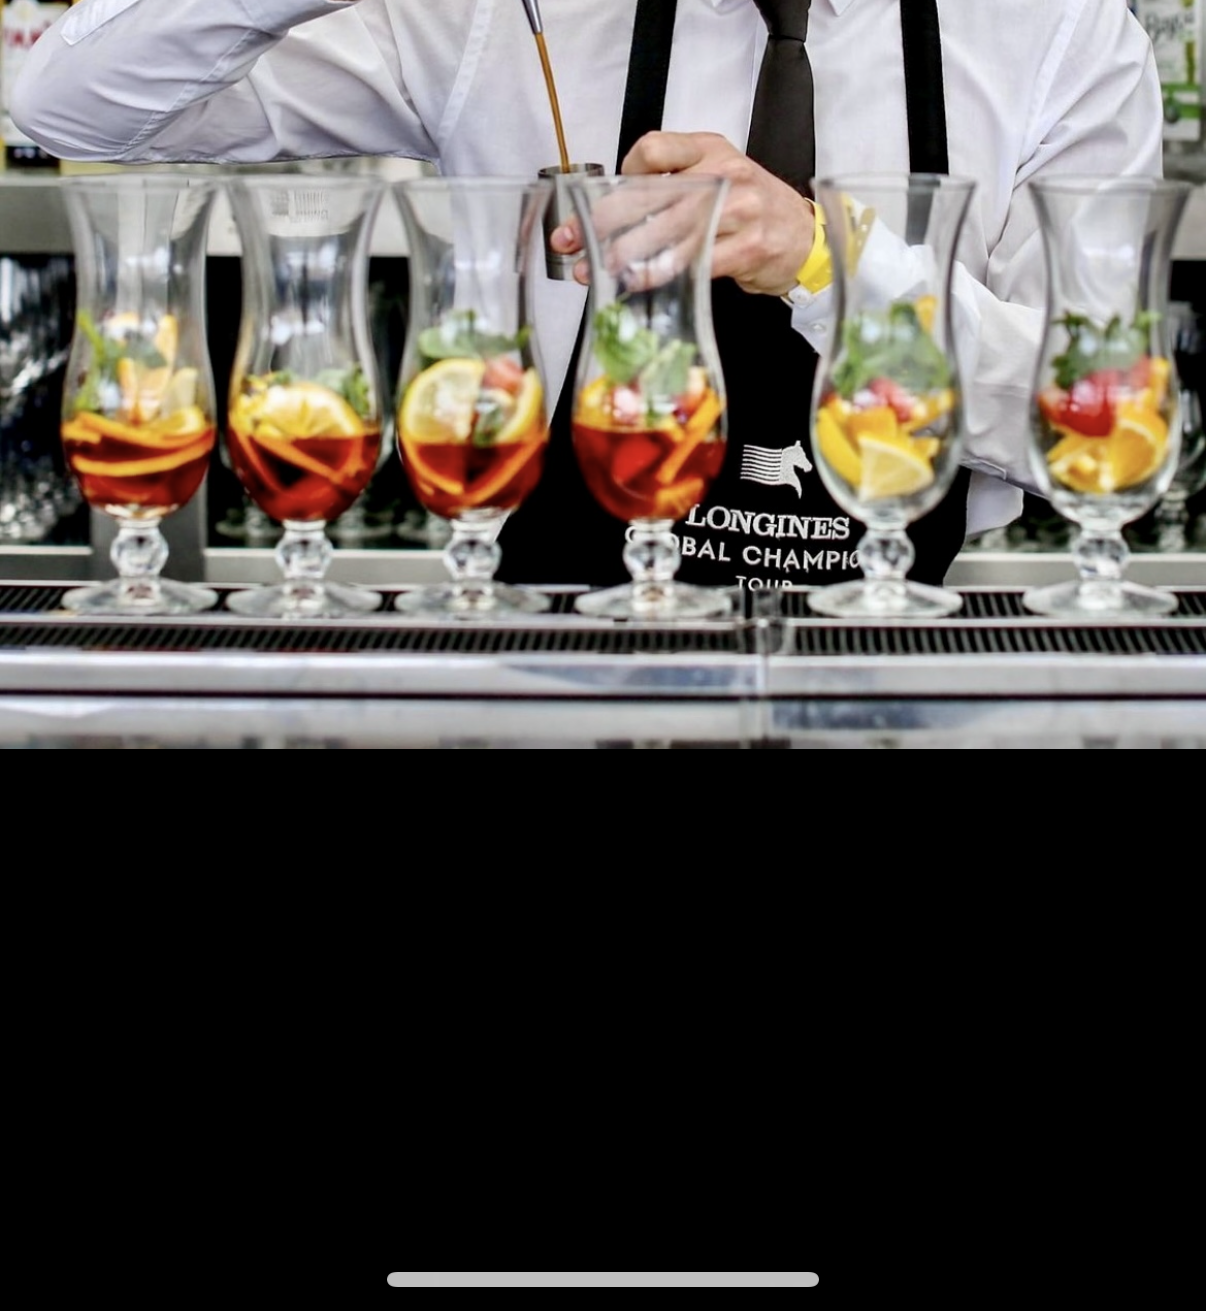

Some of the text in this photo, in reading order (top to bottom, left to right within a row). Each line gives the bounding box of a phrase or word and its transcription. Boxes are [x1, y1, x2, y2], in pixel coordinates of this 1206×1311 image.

[686, 504, 851, 540] LONGINES
[625, 526, 860, 571] BAL CHAMPIO
